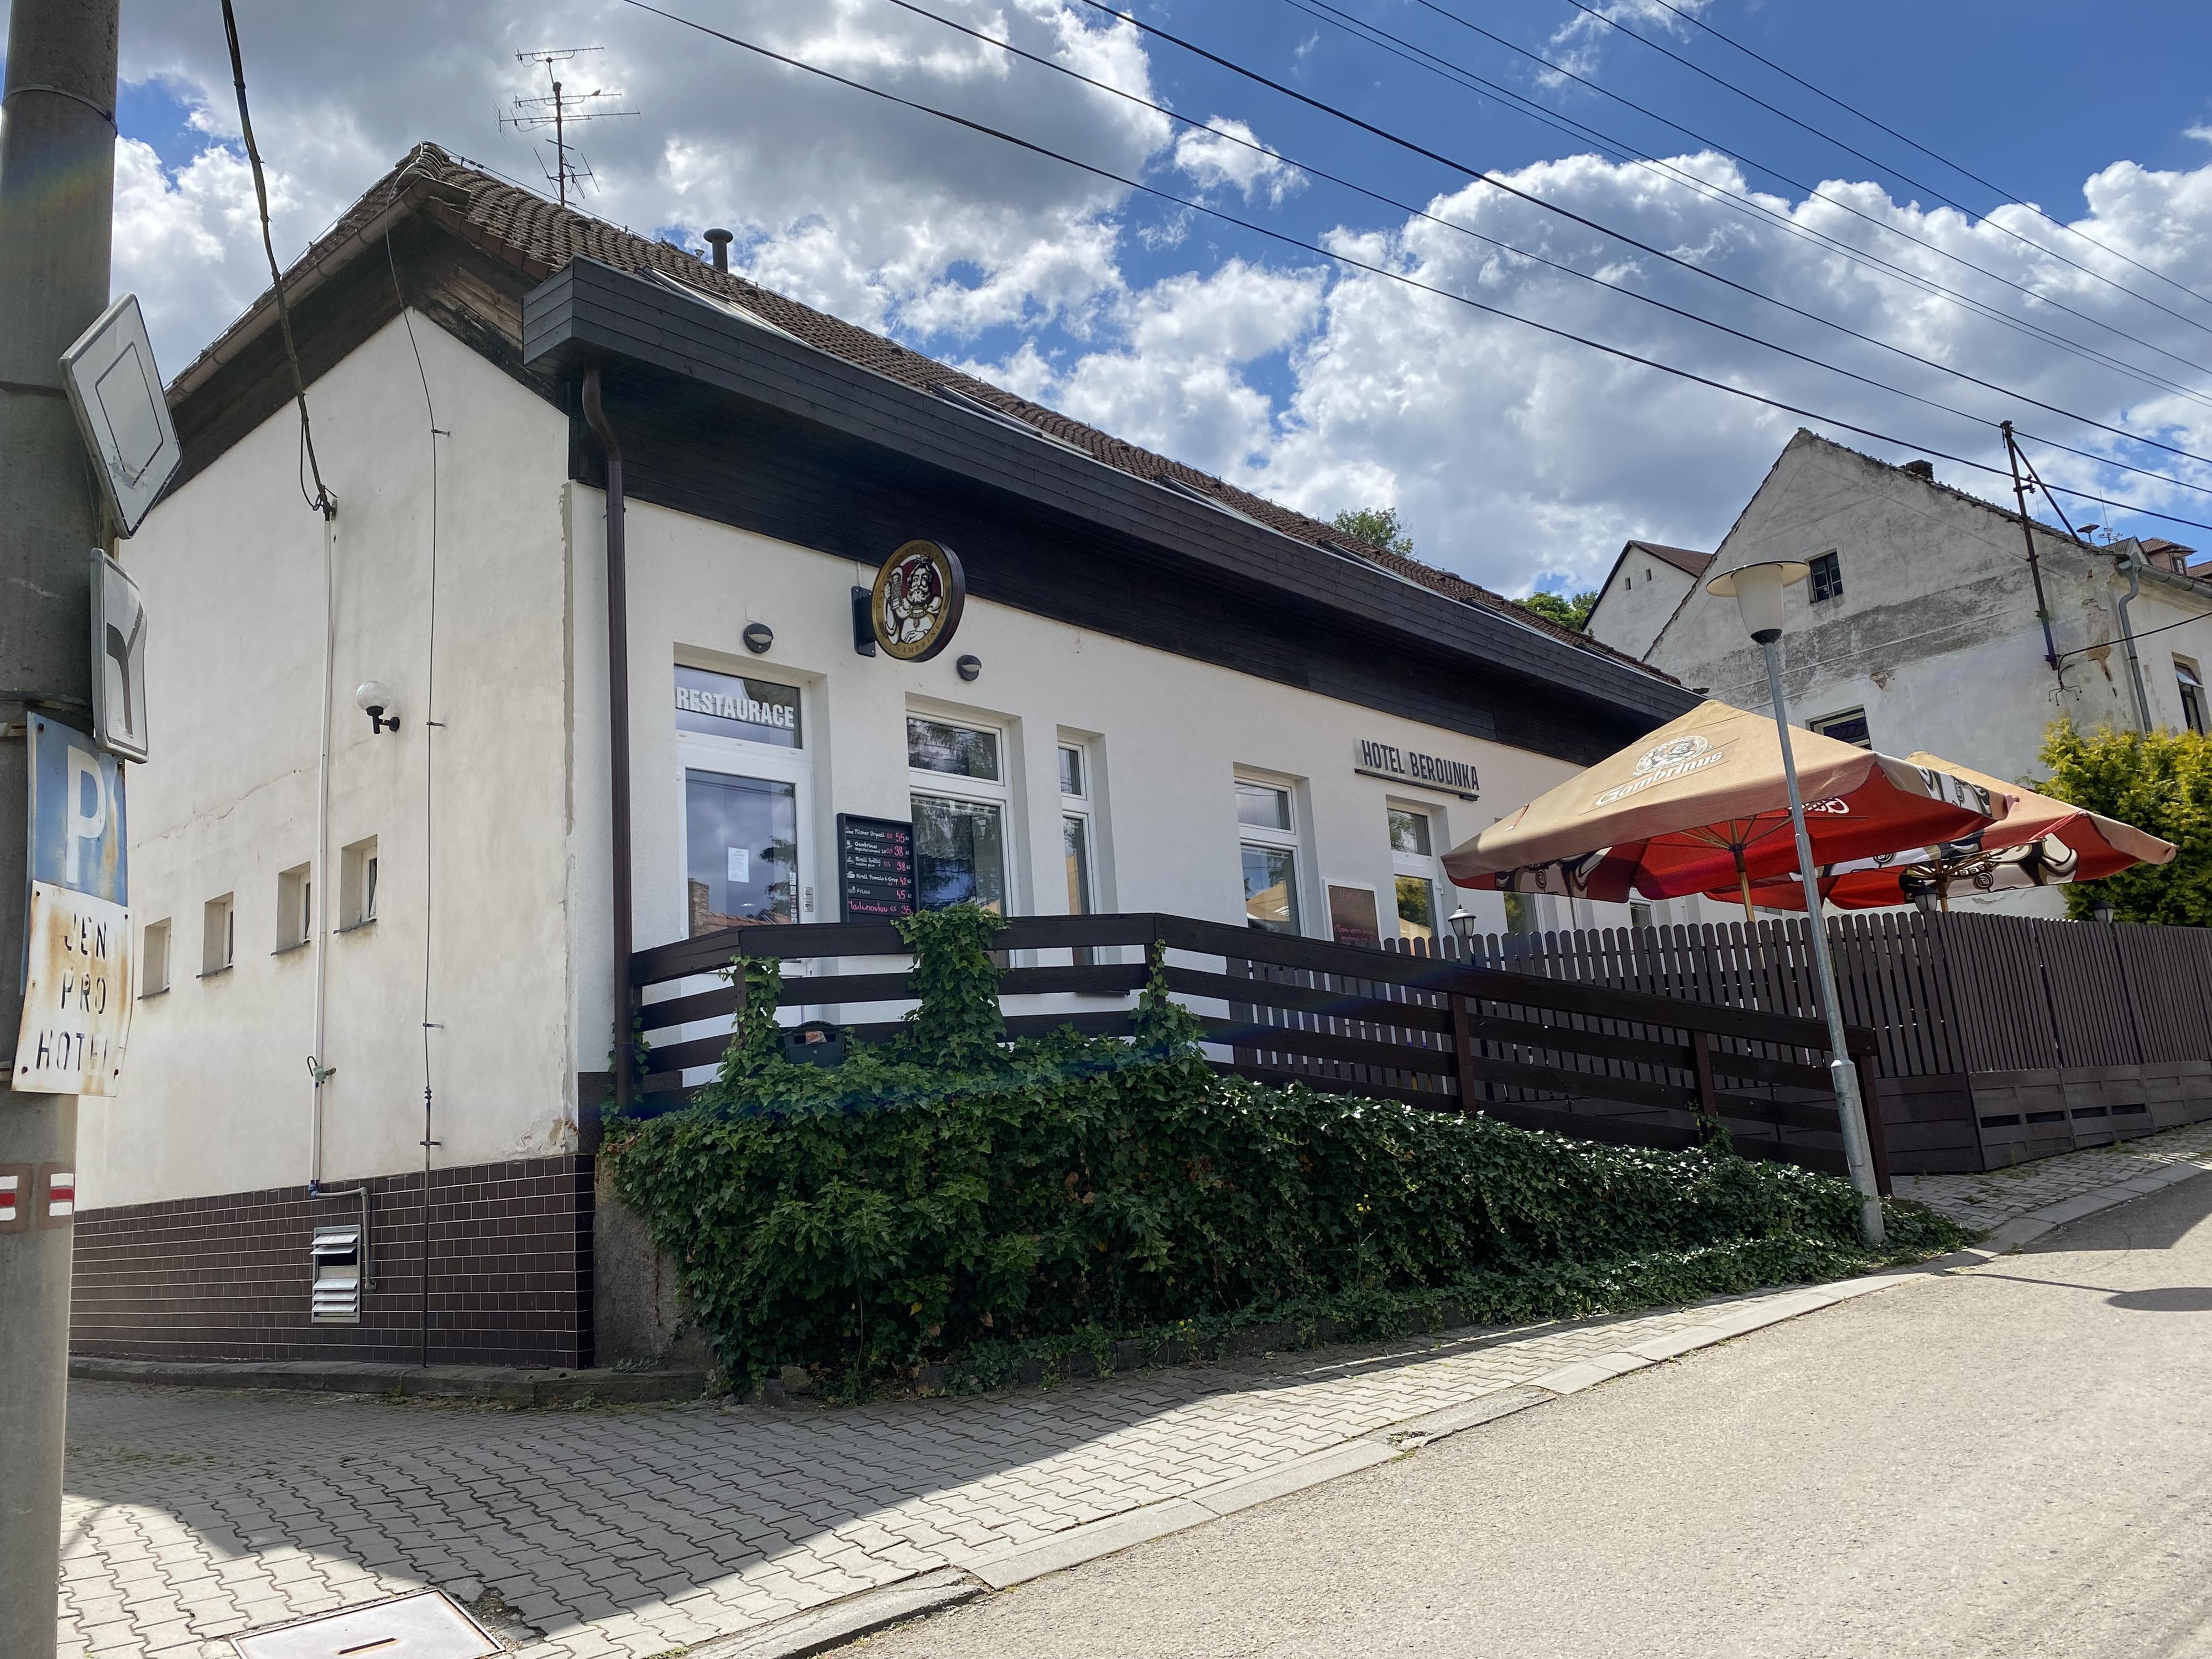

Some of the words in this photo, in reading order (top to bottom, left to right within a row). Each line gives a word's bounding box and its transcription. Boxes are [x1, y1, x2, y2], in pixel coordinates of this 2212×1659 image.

[896, 615, 944, 654] GAMBRINUS
[676, 686, 795, 728] RESTAURACE
[1361, 739, 1405, 774] HOTEL
[1409, 751, 1479, 791] BEROUNKA
[1595, 752, 1724, 805] Gambrinus
[66, 744, 107, 885] P
[894, 846, 904, 857] 38
[895, 832, 905, 843] 55
[896, 861, 906, 872] 38
[900, 877, 907, 885] 42
[896, 889, 906, 899] 45
[64, 912, 106, 961] JEN
[60, 966, 107, 1015] PRO
